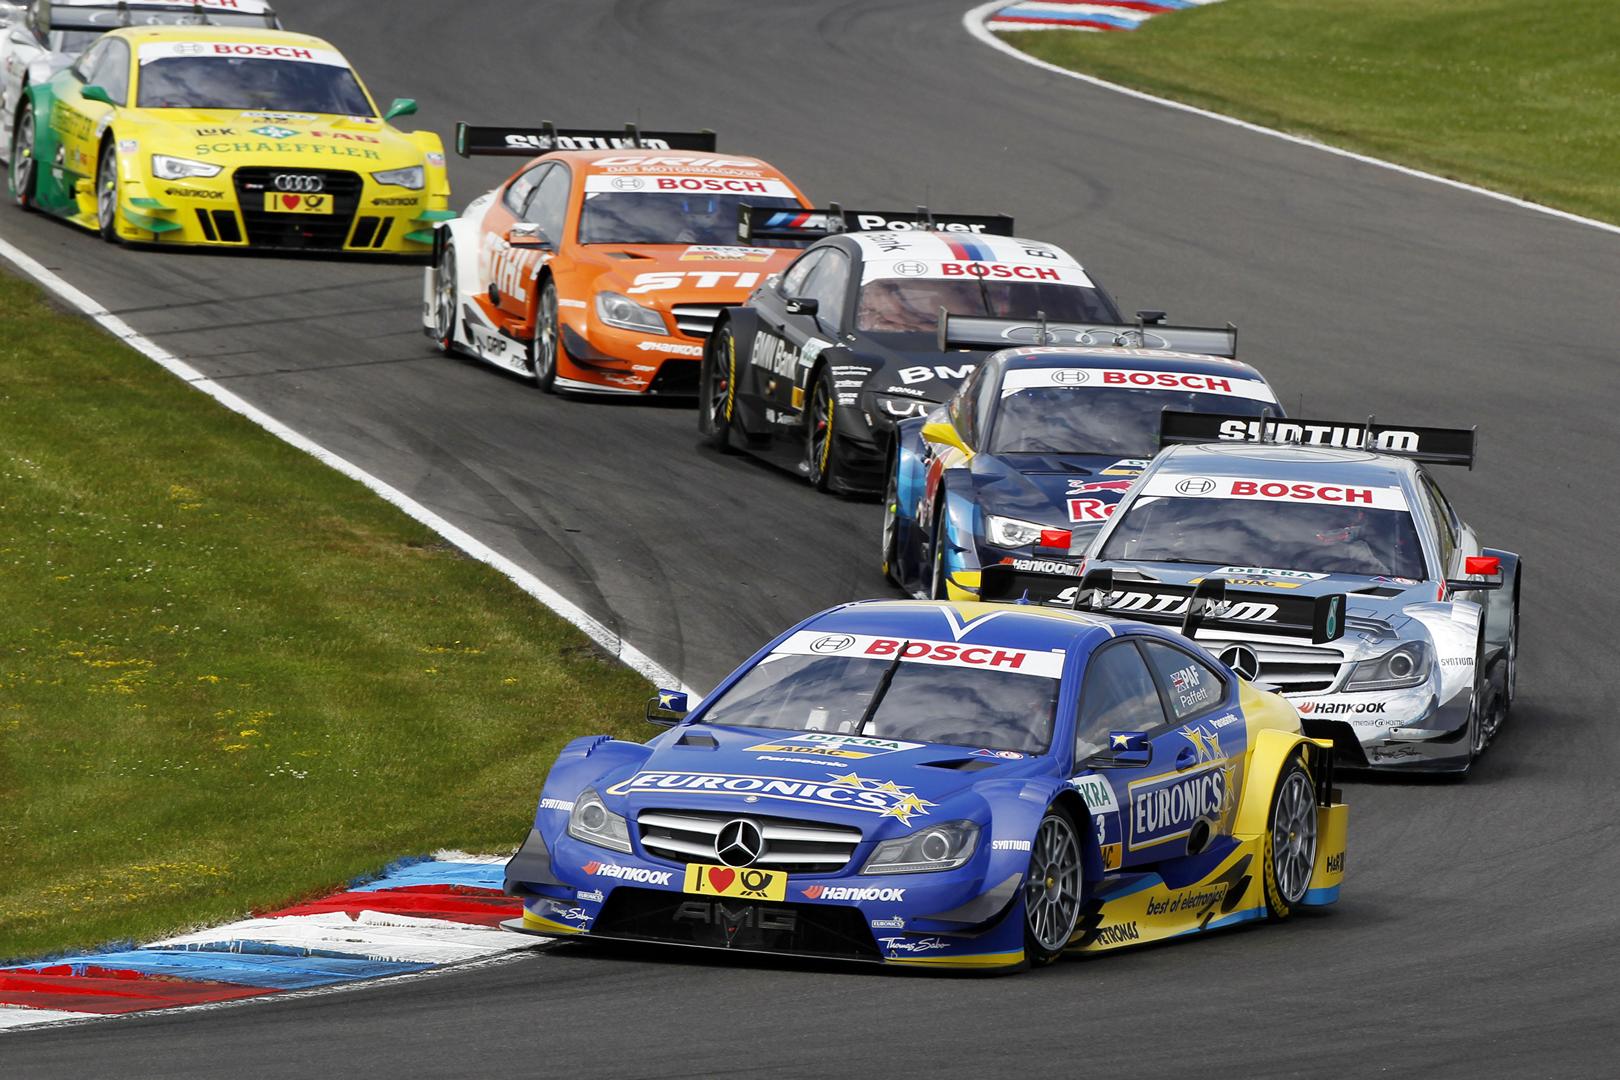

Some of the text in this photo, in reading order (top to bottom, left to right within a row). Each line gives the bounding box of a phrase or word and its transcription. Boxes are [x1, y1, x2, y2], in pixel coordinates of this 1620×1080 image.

[213, 43, 312, 60] BOSCH
[309, 130, 380, 144] FAG
[195, 142, 381, 160] SCHAEFFLER
[591, 156, 762, 167] GRIP
[607, 166, 762, 178] DAS MOTORMAGAZIN
[657, 178, 768, 193] BOSCH
[941, 262, 1060, 281] BOSCH
[627, 271, 778, 293] STI
[1103, 371, 1232, 392] BOSCH
[1230, 480, 1373, 503] BOSCH
[1227, 566, 1313, 580] DEKRA
[864, 639, 1026, 669] BOSCH
[1179, 665, 1200, 689] PAF
[1179, 687, 1208, 708] Paffett
[805, 734, 899, 749] DEKRA
[776, 746, 846, 756] ADAC
[756, 755, 848, 768] Panasonic
[631, 774, 888, 807] EURONICS
[540, 798, 575, 811] SYNTIUM
[1136, 772, 1222, 834] EURONICS
[1095, 814, 1106, 844] 3
[992, 840, 1031, 852] SYNTIUM
[1146, 886, 1227, 916] best of electronics!
[565, 908, 593, 921] Sabo
[673, 901, 797, 931] AMG
[1096, 921, 1139, 946] PETRONAS
[878, 937, 951, 952] Thomas Sabo
